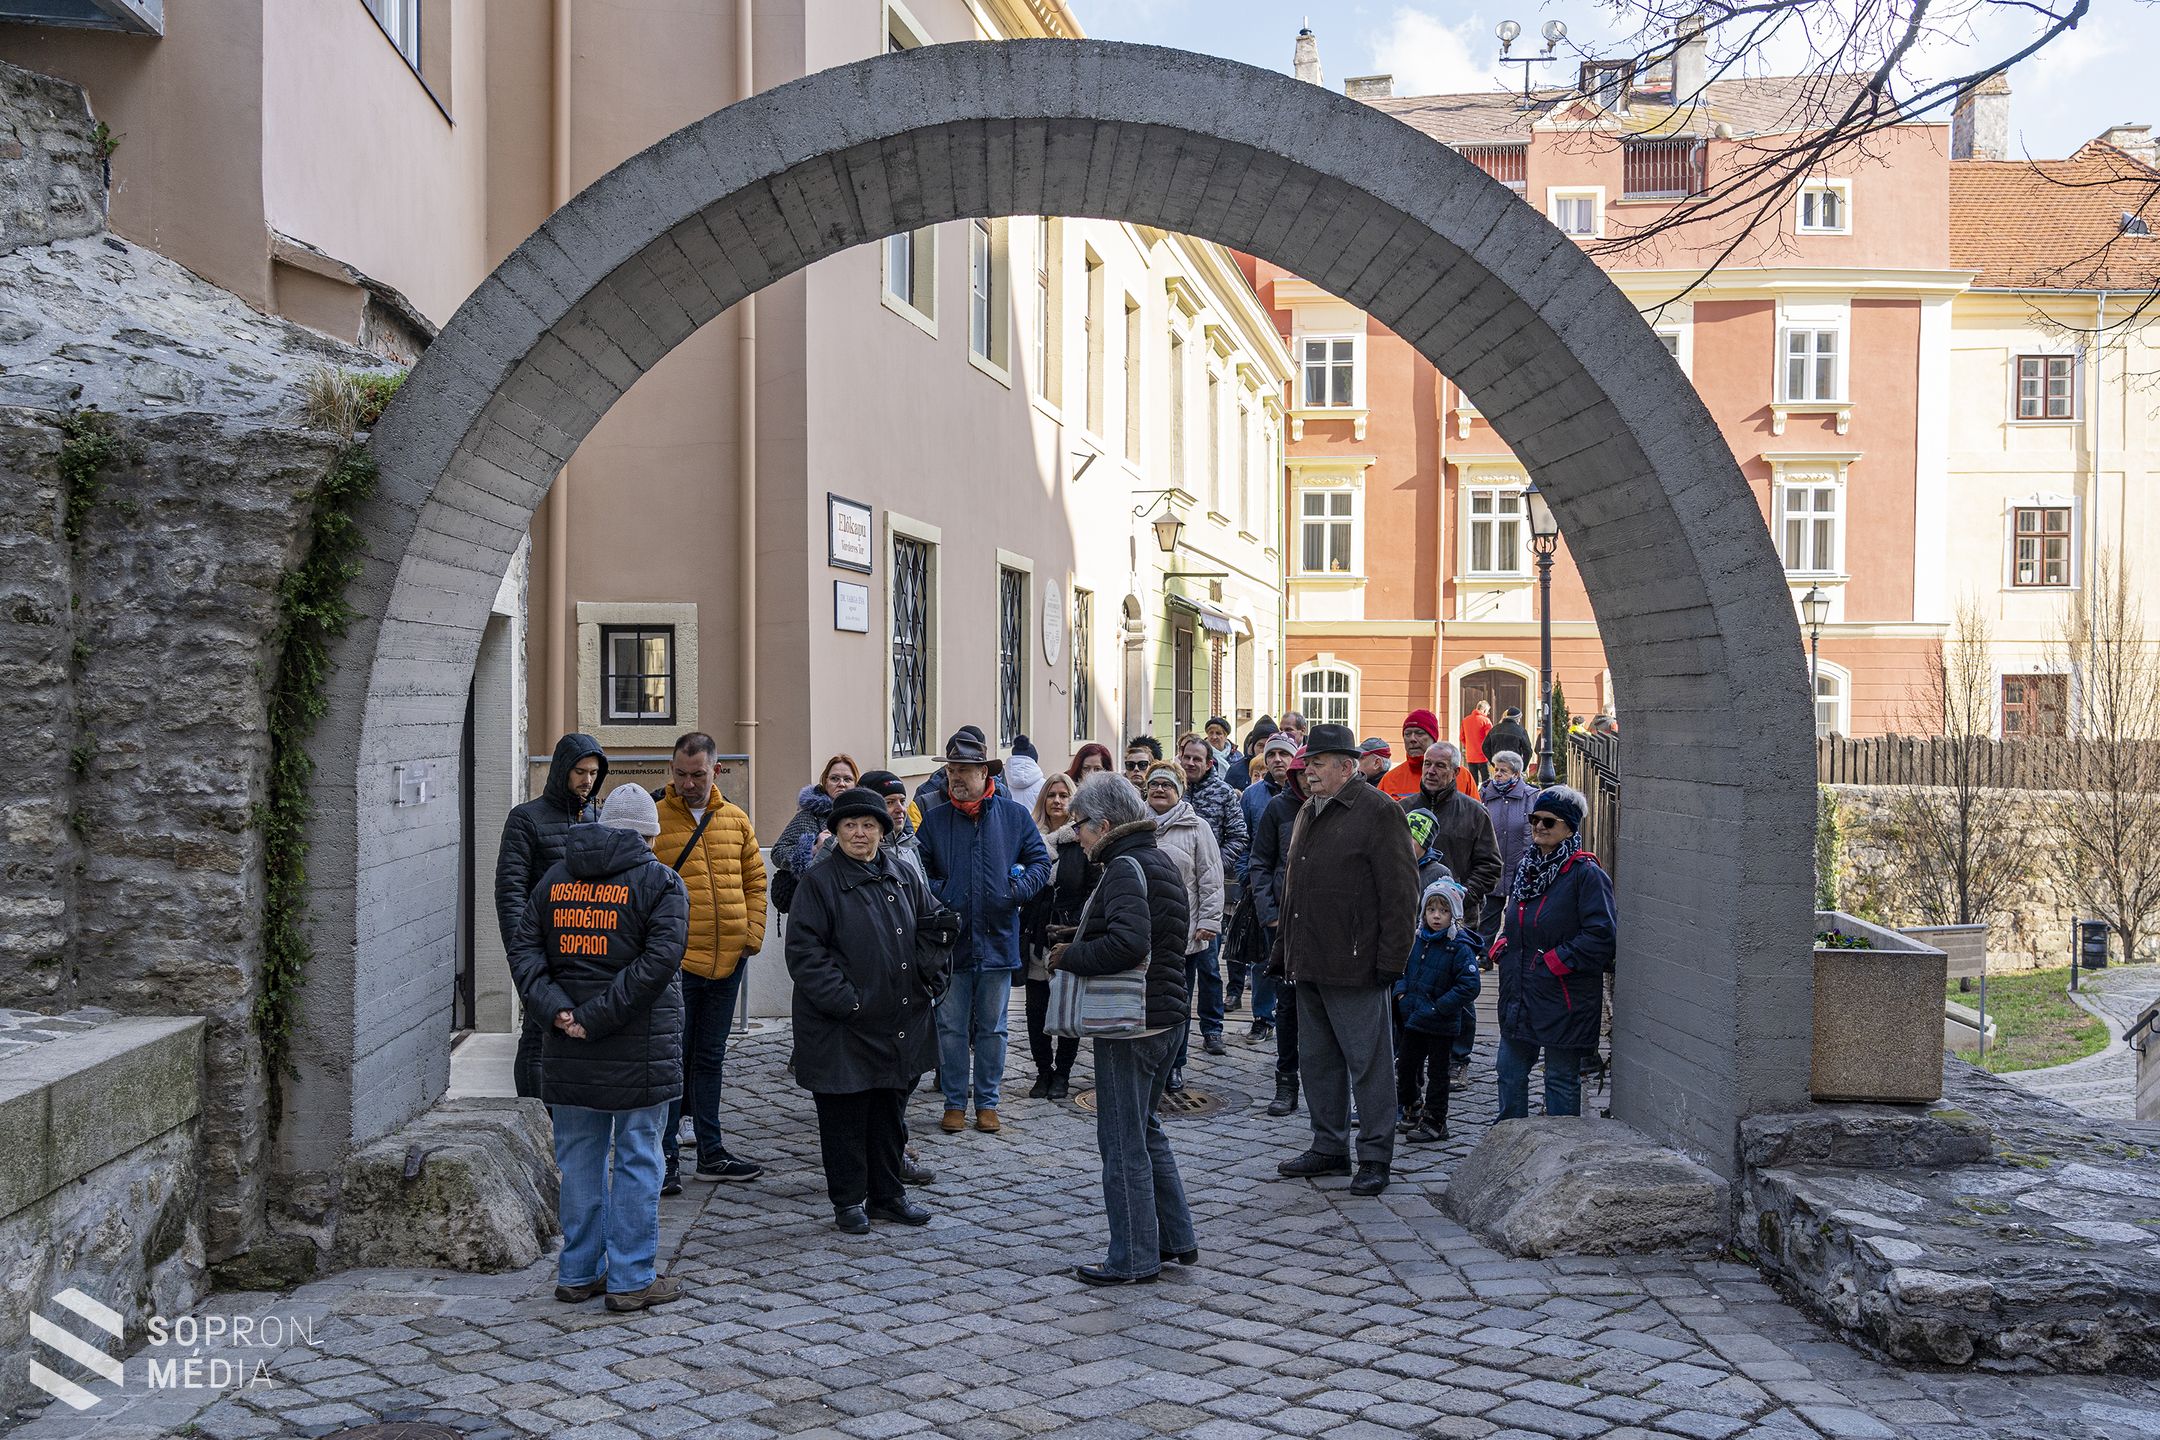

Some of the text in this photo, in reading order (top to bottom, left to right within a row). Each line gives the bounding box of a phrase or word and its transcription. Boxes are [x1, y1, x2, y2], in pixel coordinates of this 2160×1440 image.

[550, 880, 629, 905] KOSÁRLABDA
[553, 906, 618, 929] AKADÉMIA
[560, 934, 608, 955] SOPRON
